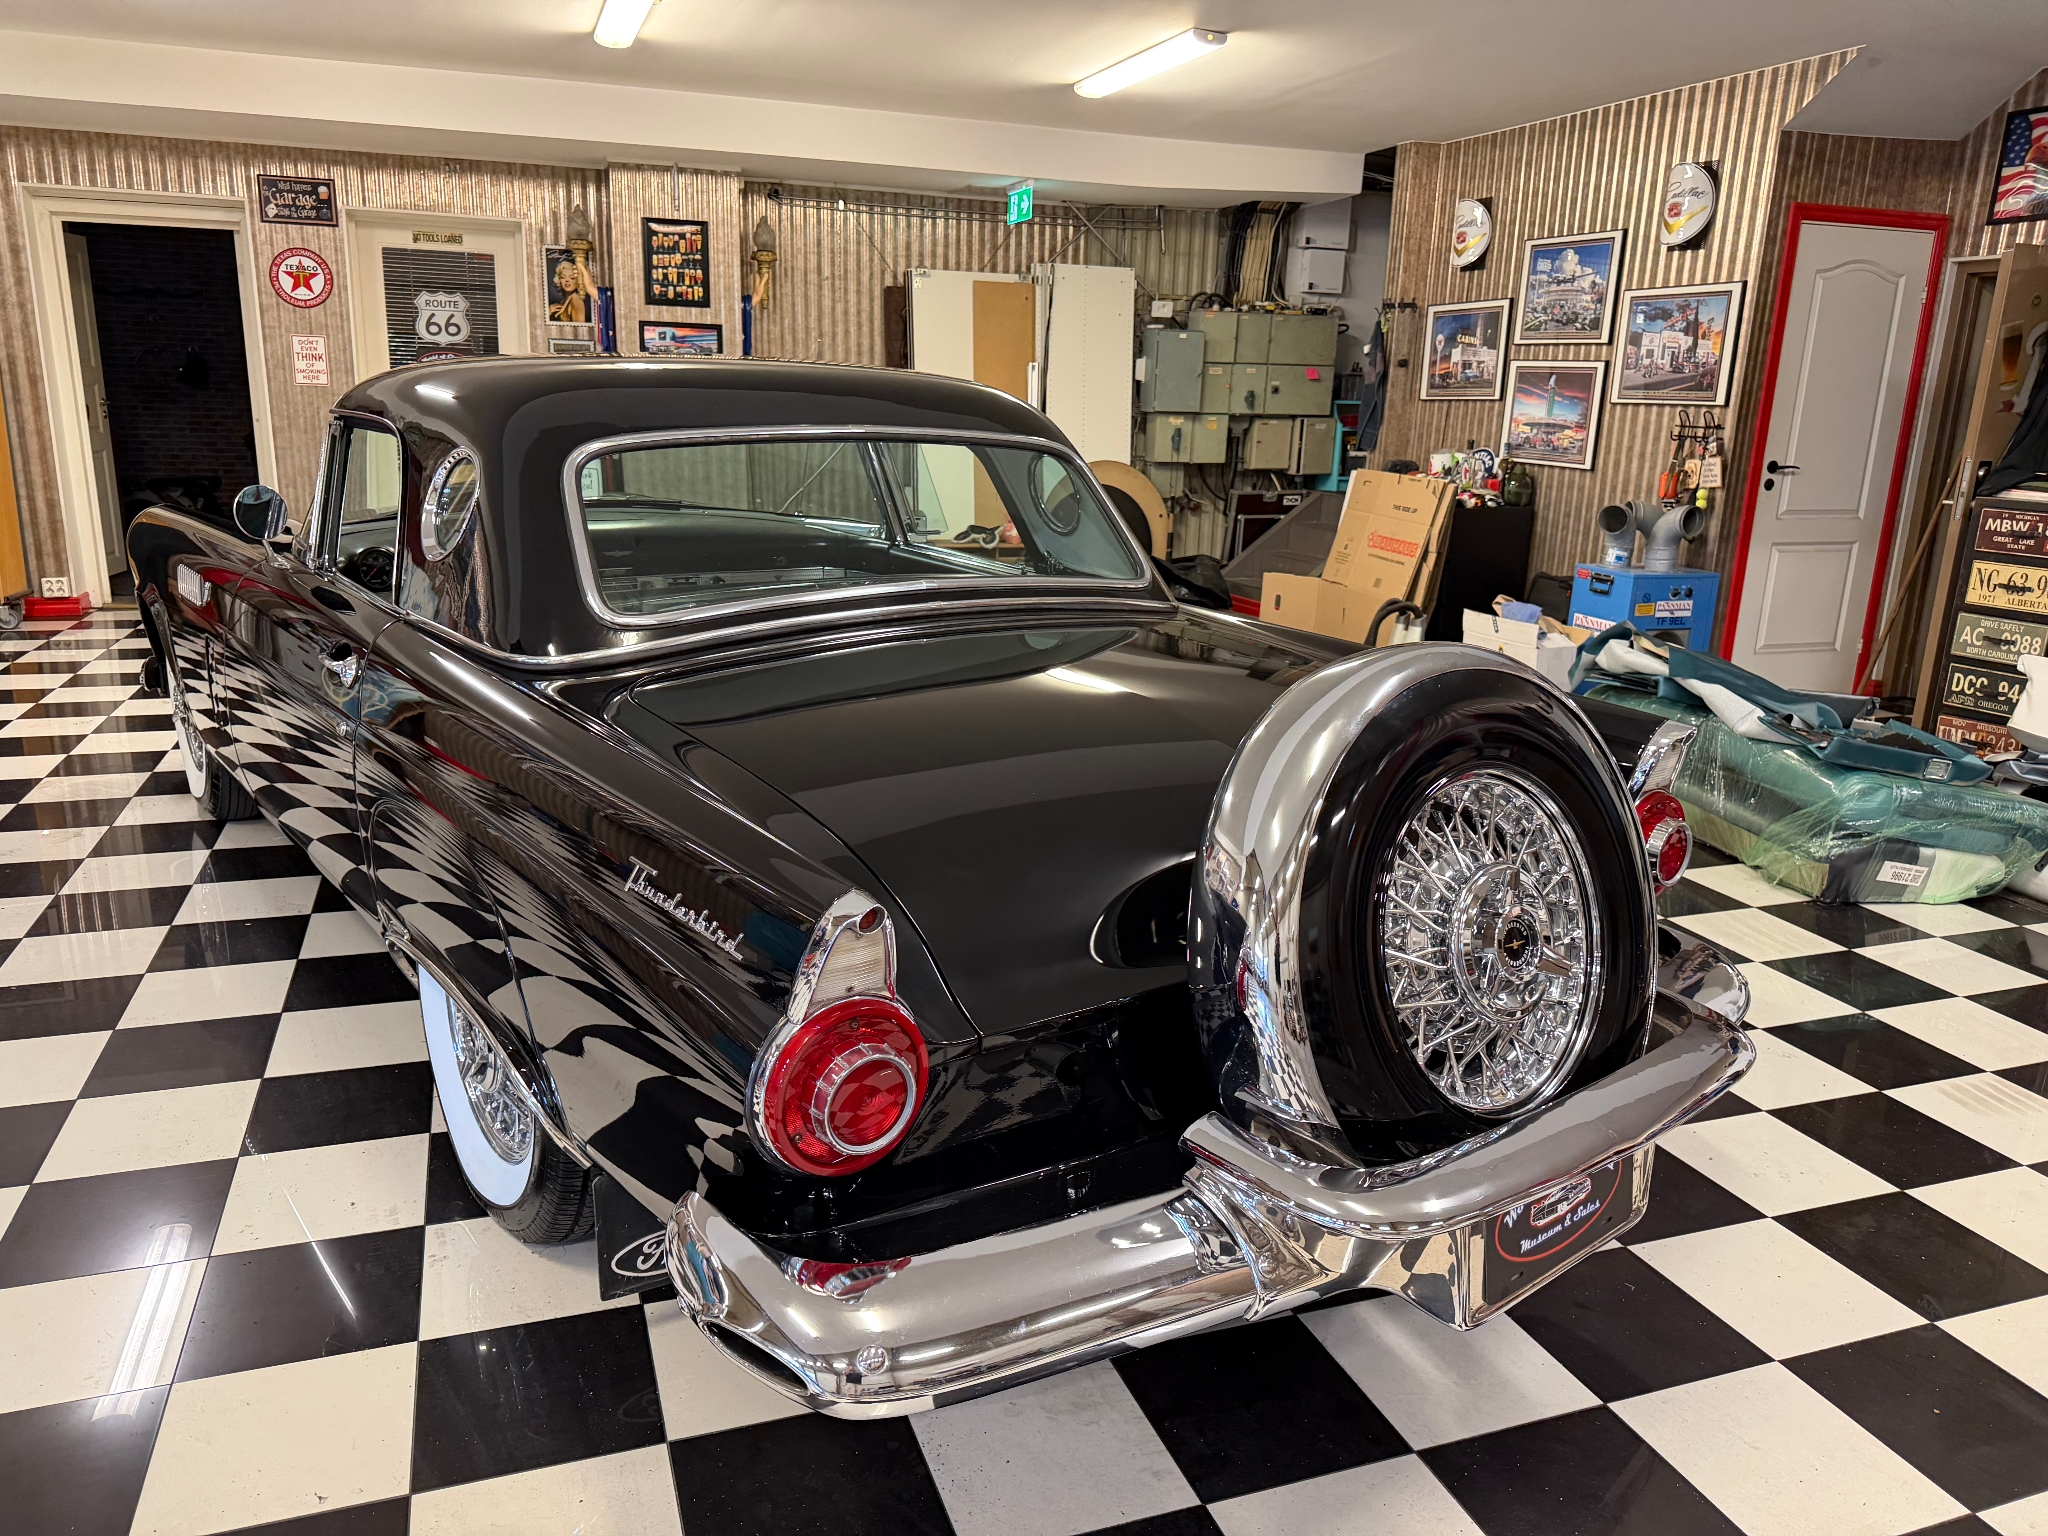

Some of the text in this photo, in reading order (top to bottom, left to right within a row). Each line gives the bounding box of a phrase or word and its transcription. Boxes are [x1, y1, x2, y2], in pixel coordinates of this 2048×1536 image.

[421, 233, 440, 243] TOOLS
[440, 233, 463, 245] LOANED
[276, 251, 291, 265] TEXAS
[292, 249, 322, 264] COMPANY
[284, 263, 319, 272] TEXACO
[425, 299, 460, 309] ROUTE
[425, 312, 462, 337] 66
[1457, 333, 1478, 345] CABINS
[295, 351, 325, 362] THINK
[1984, 518, 2031, 533] MBW
[1374, 535, 1419, 558] BAUHAUS
[1992, 535, 2035, 546] GREAT LAKE
[1971, 567, 2000, 593] NG
[1657, 602, 1691, 611] PANNMAN
[1978, 593, 2048, 611] 1971 ALBERTA
[1656, 616, 1686, 626] TF 9EL
[1980, 619, 2025, 633] DRIVE SAFELY
[1959, 625, 1985, 646] AC
[1966, 646, 2018, 661] NORTH CAROLINA
[1977, 700, 2009, 712] OREGON
[1976, 723, 2008, 734] MISSOURI
[623, 855, 745, 961] Thunderbird
[1519, 1199, 1601, 1254] Museum & Sales
